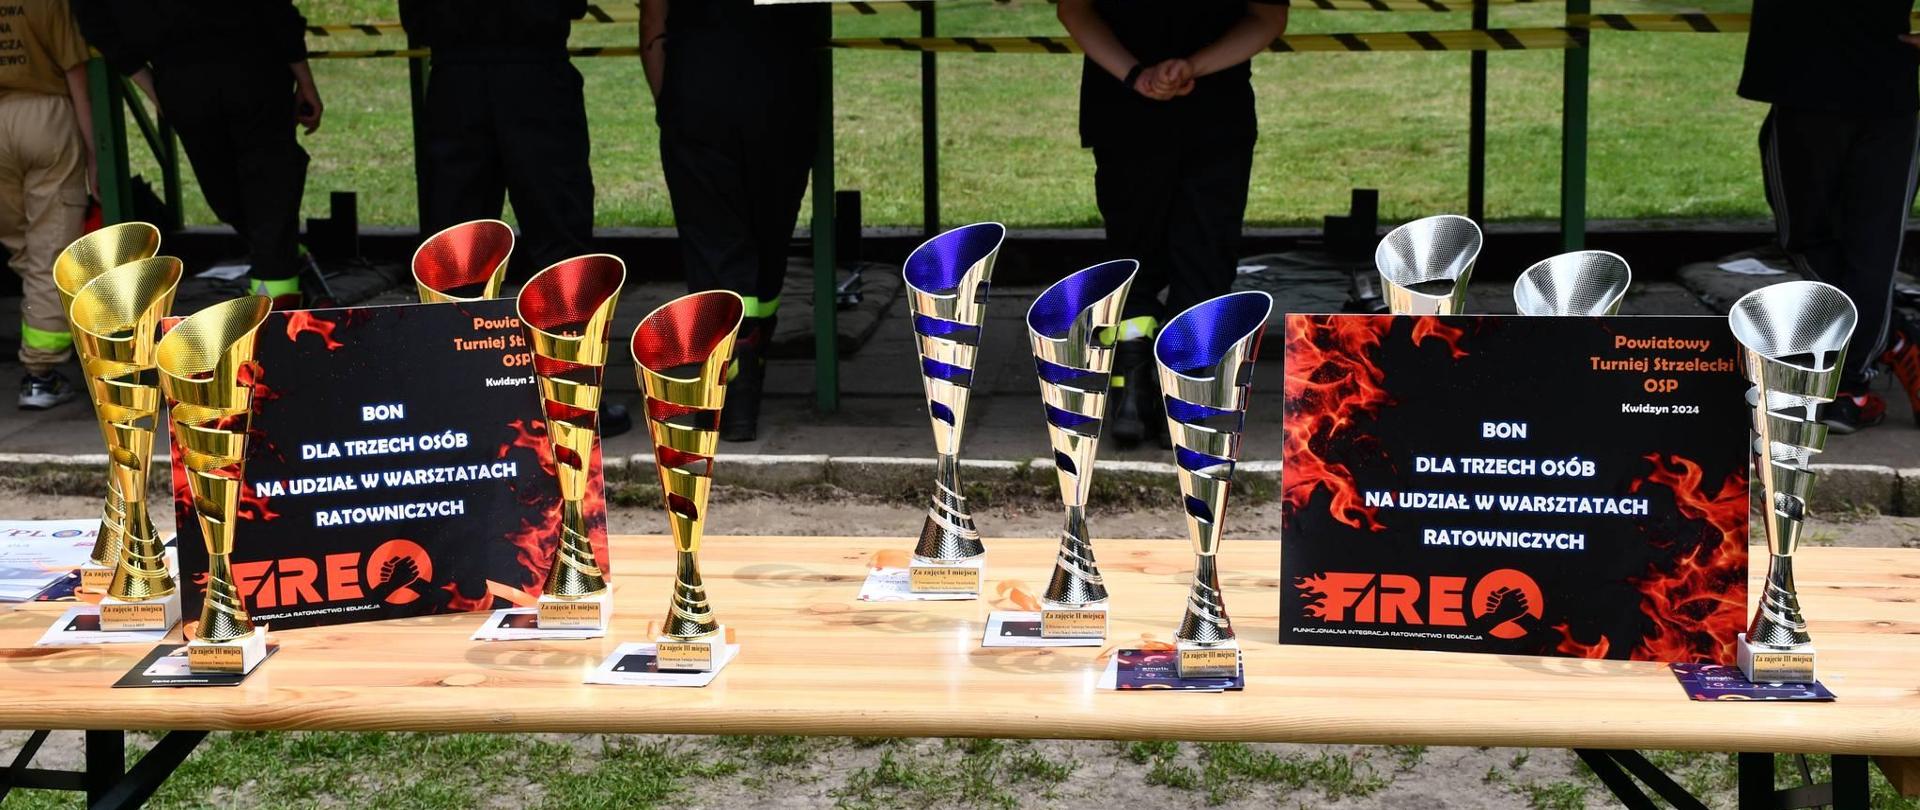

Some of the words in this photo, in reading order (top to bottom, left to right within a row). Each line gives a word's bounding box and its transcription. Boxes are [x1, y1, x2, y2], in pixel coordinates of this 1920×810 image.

[473, 316, 520, 330] Powia
[454, 336, 506, 350] Turniej
[1615, 335, 1710, 352] Powiatowy
[502, 353, 531, 367] OSP
[1590, 357, 1649, 373] Turniej
[1653, 357, 1734, 372] Strzelecki
[485, 377, 527, 387] Kwidzyn
[1644, 378, 1679, 393] OSP
[362, 403, 404, 421] BON
[1622, 403, 1669, 415] Kwidzyn
[1671, 405, 1700, 414] 2024
[1482, 422, 1527, 439] BON
[302, 442, 341, 460] DLA
[344, 436, 415, 456] TRZECH
[418, 430, 468, 450] OSÓB
[1416, 457, 1456, 473] DLA
[1460, 458, 1536, 475] TRZECH
[1540, 456, 1596, 477] OSÓB
[256, 481, 286, 498] NA
[289, 476, 358, 495] UDZIAŁ
[361, 472, 380, 489] W
[383, 462, 517, 487] WARSZTATACH
[1365, 491, 1394, 508] NA
[1399, 493, 1470, 510] UDZIAŁ
[1475, 494, 1494, 511] W
[1499, 495, 1648, 515] WARSZTATACH
[316, 500, 465, 527] RATOWNICZYCH
[1424, 528, 1585, 550] RATOWNICZYCH
[251, 612, 292, 622] INTEGRACJA
[293, 607, 342, 618] RATOWNICTWO
[346, 603, 381, 612] EDUKACJA
[1292, 627, 1347, 635] FUNKCJONALNA
[1347, 629, 1390, 637] INTEGRACJA
